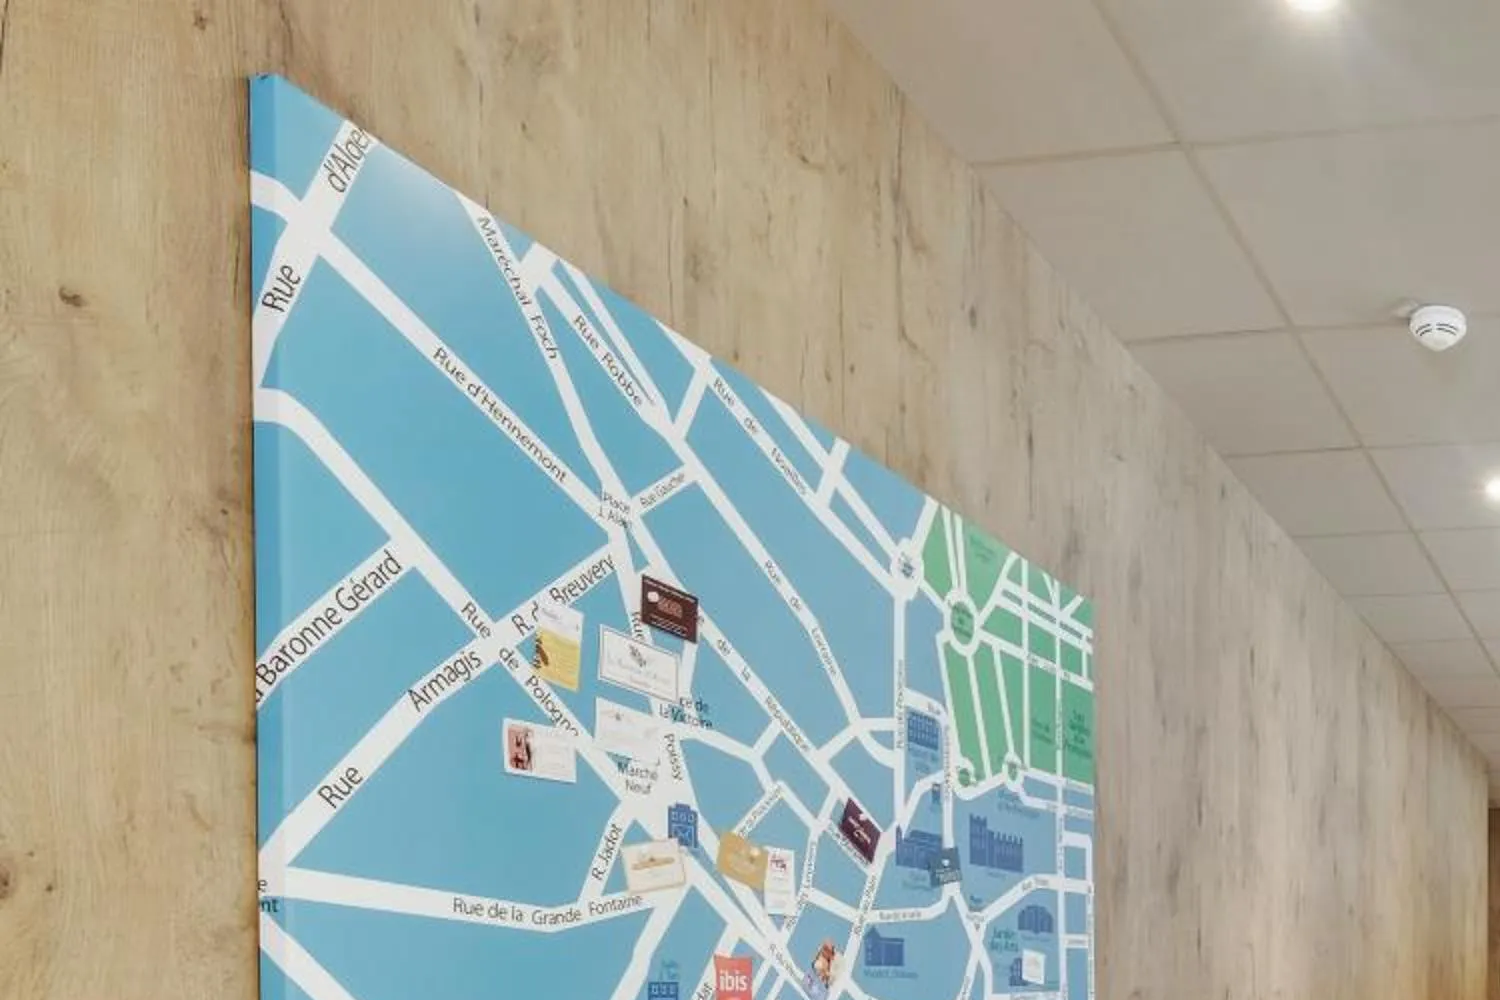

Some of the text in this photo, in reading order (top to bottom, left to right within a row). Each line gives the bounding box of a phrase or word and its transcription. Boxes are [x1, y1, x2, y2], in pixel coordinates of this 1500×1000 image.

[262, 264, 301, 312] Rue
[531, 314, 559, 361] Foch
[573, 313, 644, 407] Rue Robbe
[432, 346, 567, 484] Rue d'Hennemont
[712, 377, 736, 409] Rue
[549, 553, 616, 606] Breuvery
[256, 548, 404, 688] Baronne Gérard
[459, 600, 492, 640] Rue
[498, 646, 521, 671] de
[317, 648, 483, 810] Rue Armagis
[452, 896, 483, 918] Rue
[487, 904, 507, 922] de
[510, 906, 524, 923] la
[531, 906, 582, 926] Grande
[719, 970, 748, 992] ibis
